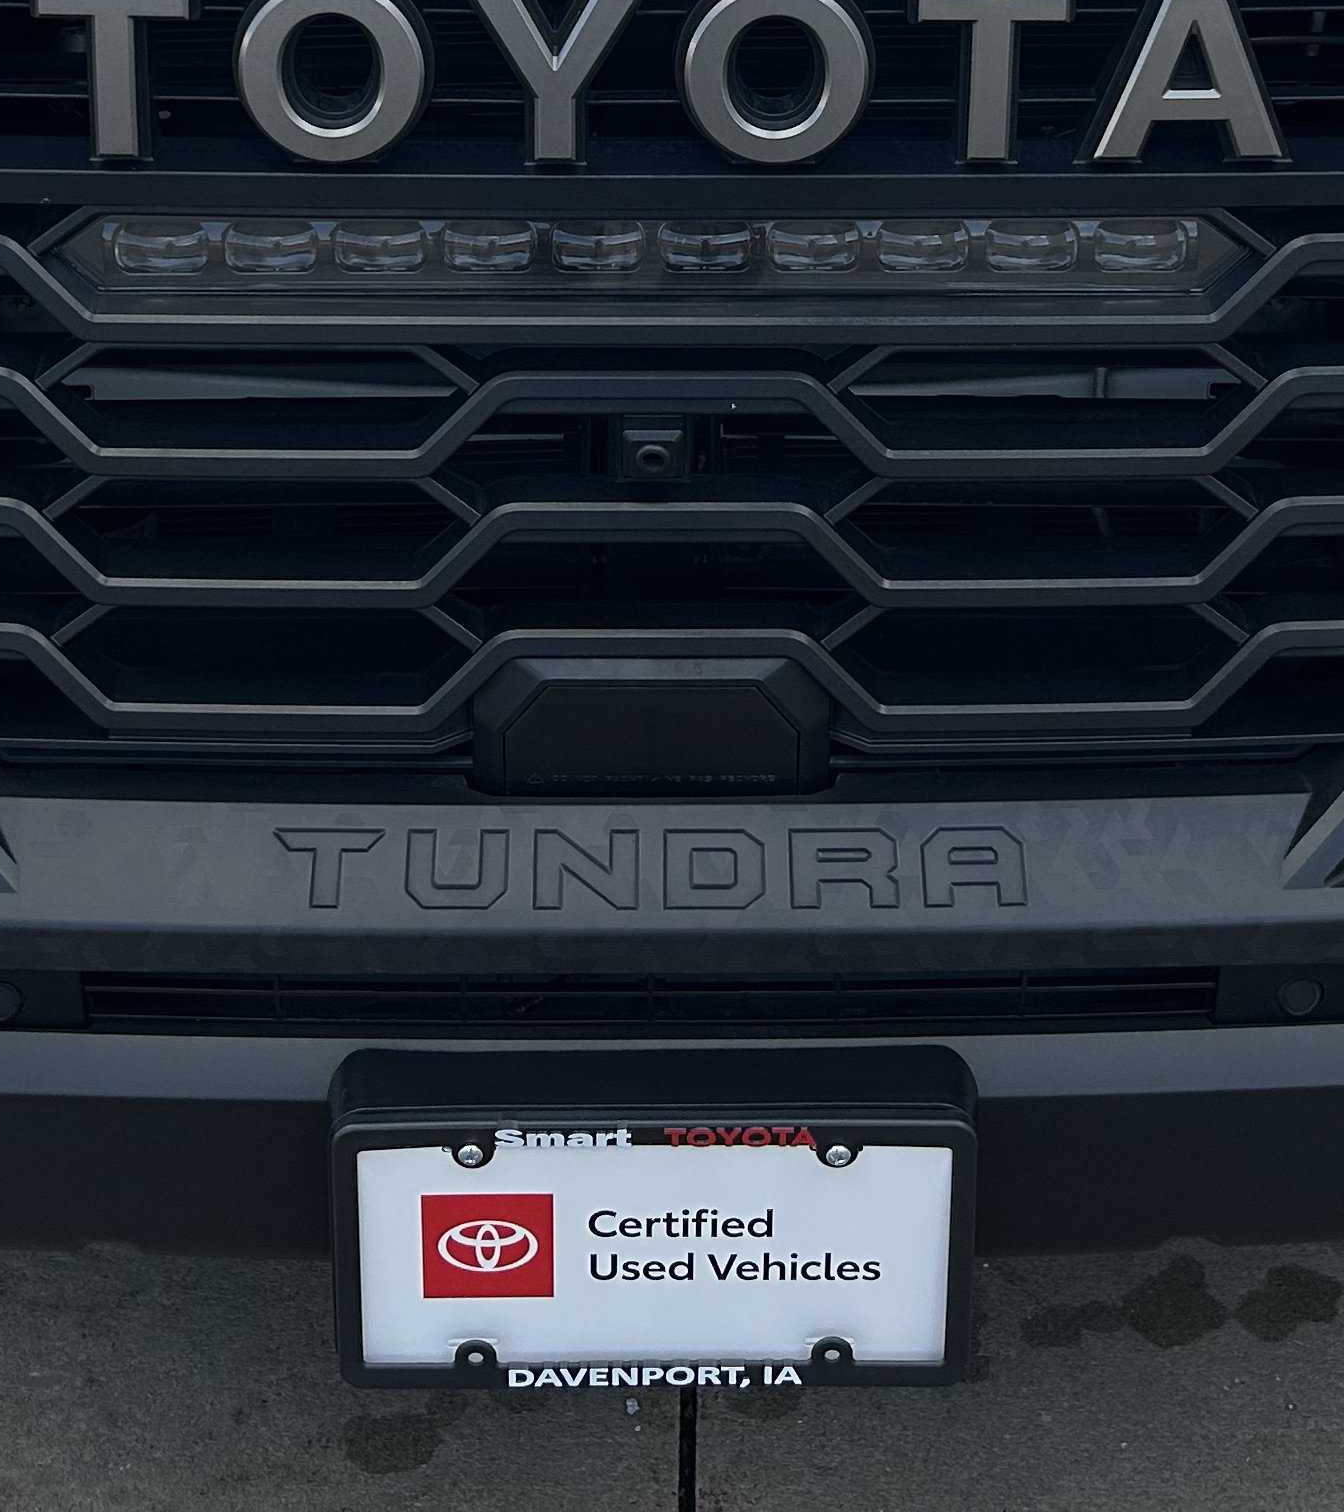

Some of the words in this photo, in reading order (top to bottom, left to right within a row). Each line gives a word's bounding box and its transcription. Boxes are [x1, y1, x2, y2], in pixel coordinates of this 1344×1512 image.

[272, 825, 1029, 911] TUNDRA
[494, 1128, 632, 1148] Smart
[663, 1126, 817, 1148] TOYOTA
[588, 1208, 774, 1238] Certified
[589, 1252, 695, 1281] Used
[707, 1252, 882, 1282] Vehicles
[508, 1366, 750, 1388] DAVENPORT,
[763, 1365, 802, 1385] IA
